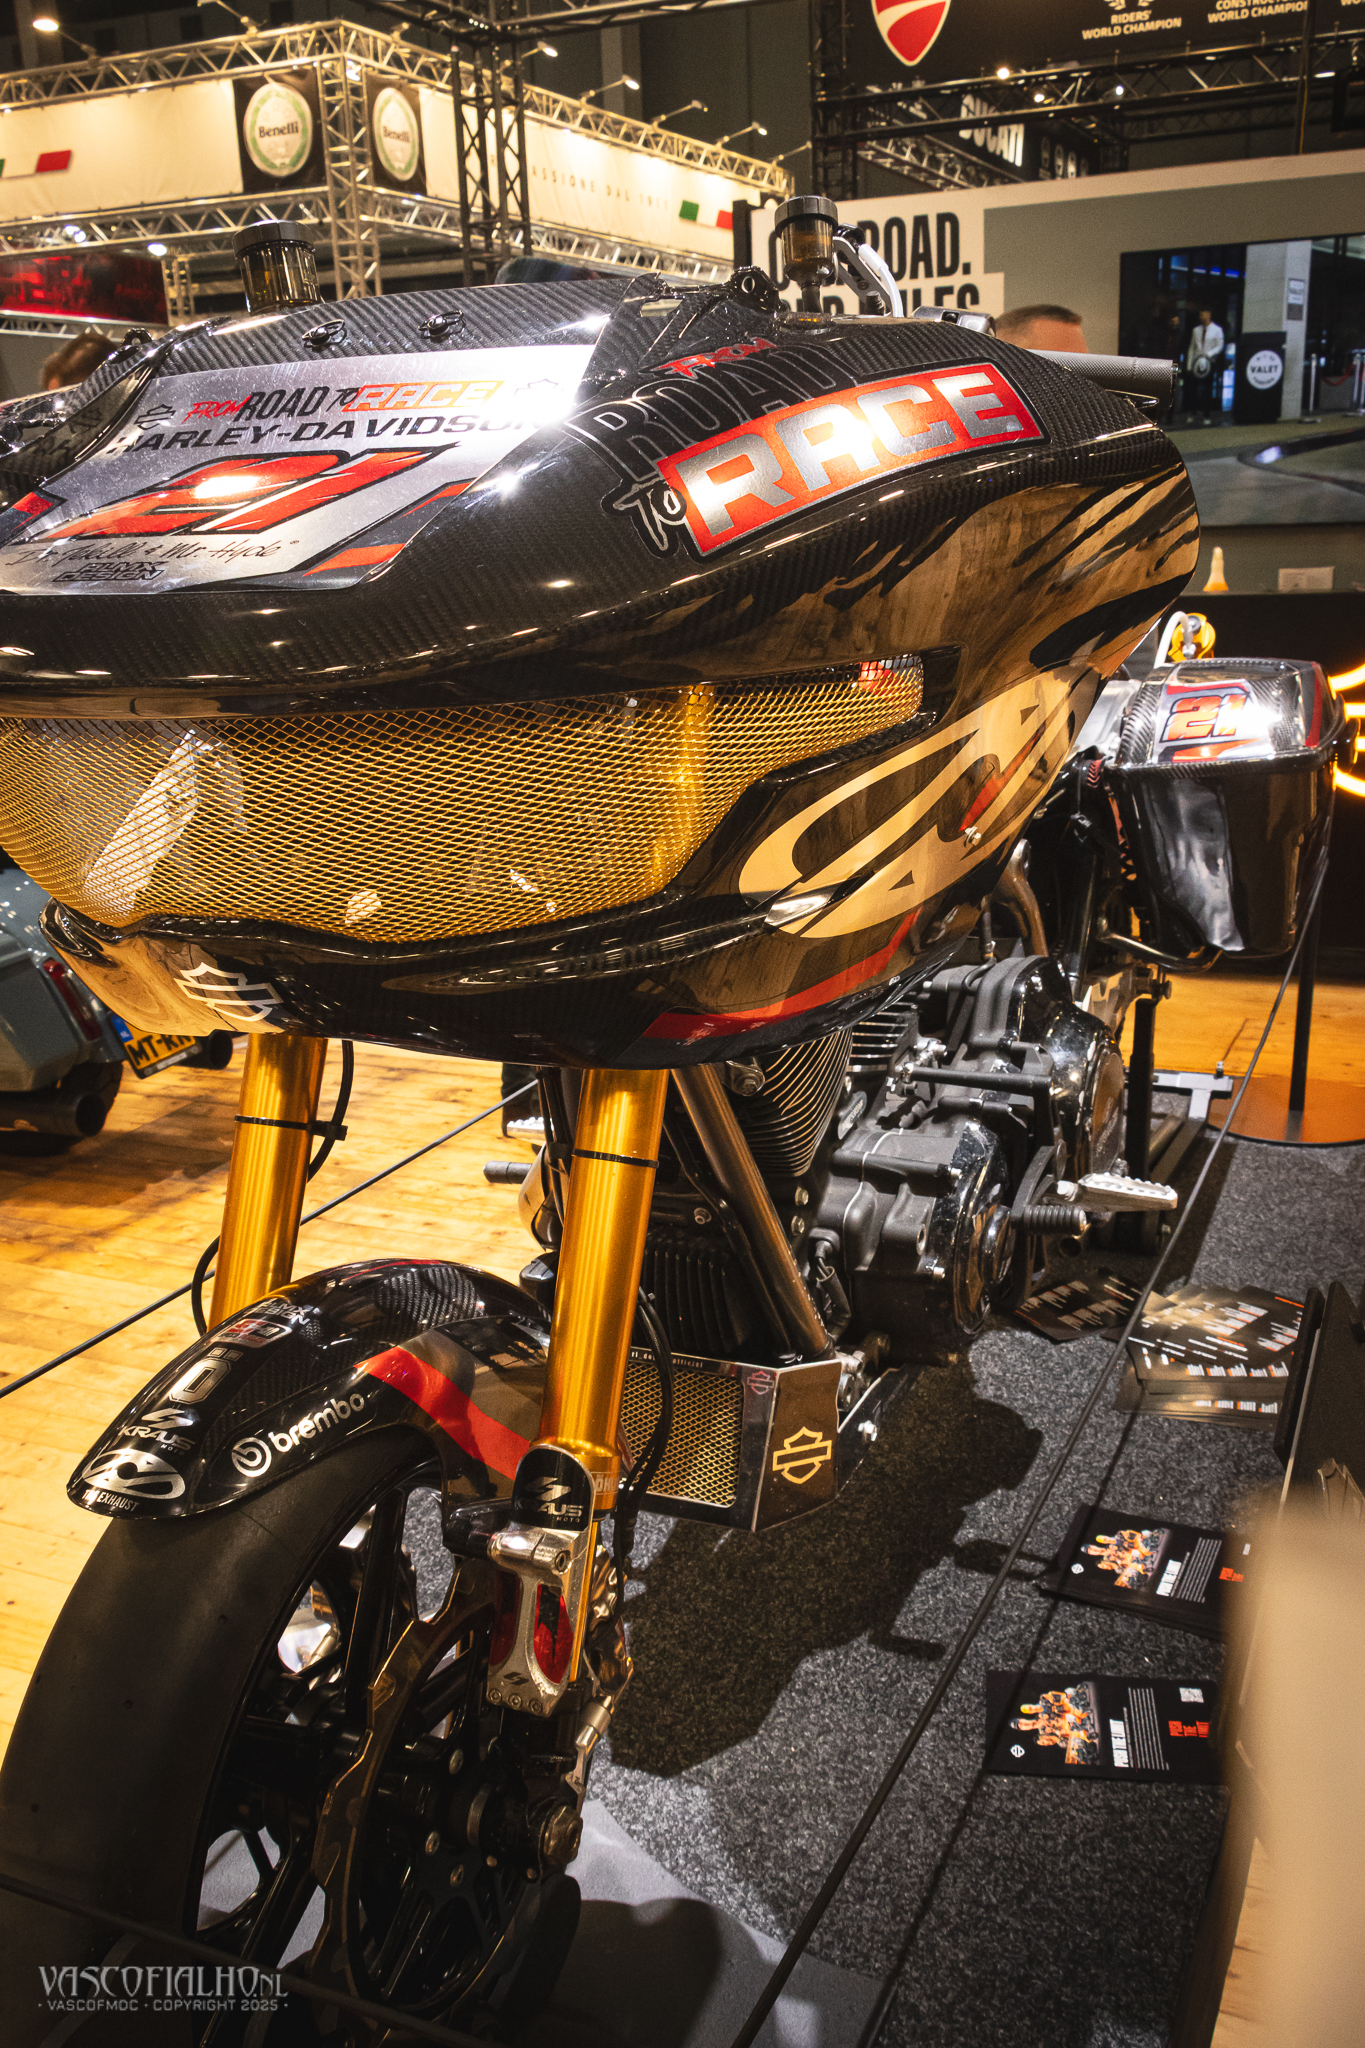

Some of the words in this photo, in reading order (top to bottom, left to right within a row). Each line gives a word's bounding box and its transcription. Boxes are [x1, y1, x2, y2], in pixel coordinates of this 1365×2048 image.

[1208, 9, 1249, 24] WORLD
[1082, 25, 1122, 40] WORLD
[1123, 17, 1182, 34] CHAMPION
[258, 121, 299, 139] Benelli
[382, 125, 410, 143] Benelli
[532, 165, 596, 193] ASSIONE
[1249, 364, 1278, 374] VALET
[181, 394, 252, 424] FROM
[233, 386, 330, 423] ROAD
[348, 381, 500, 411] RACE
[674, 372, 1025, 537] RACE
[20, 441, 460, 546] 21
[163, 542, 206, 559] Mr.
[1159, 693, 1250, 743] 21
[267, 1393, 365, 1453] brembo
[118, 1425, 197, 1452] KRAUS
[160, 1443, 185, 1456] MOTO
[97, 1491, 140, 1512] EXHAUST
[538, 1502, 584, 1518] AUS
